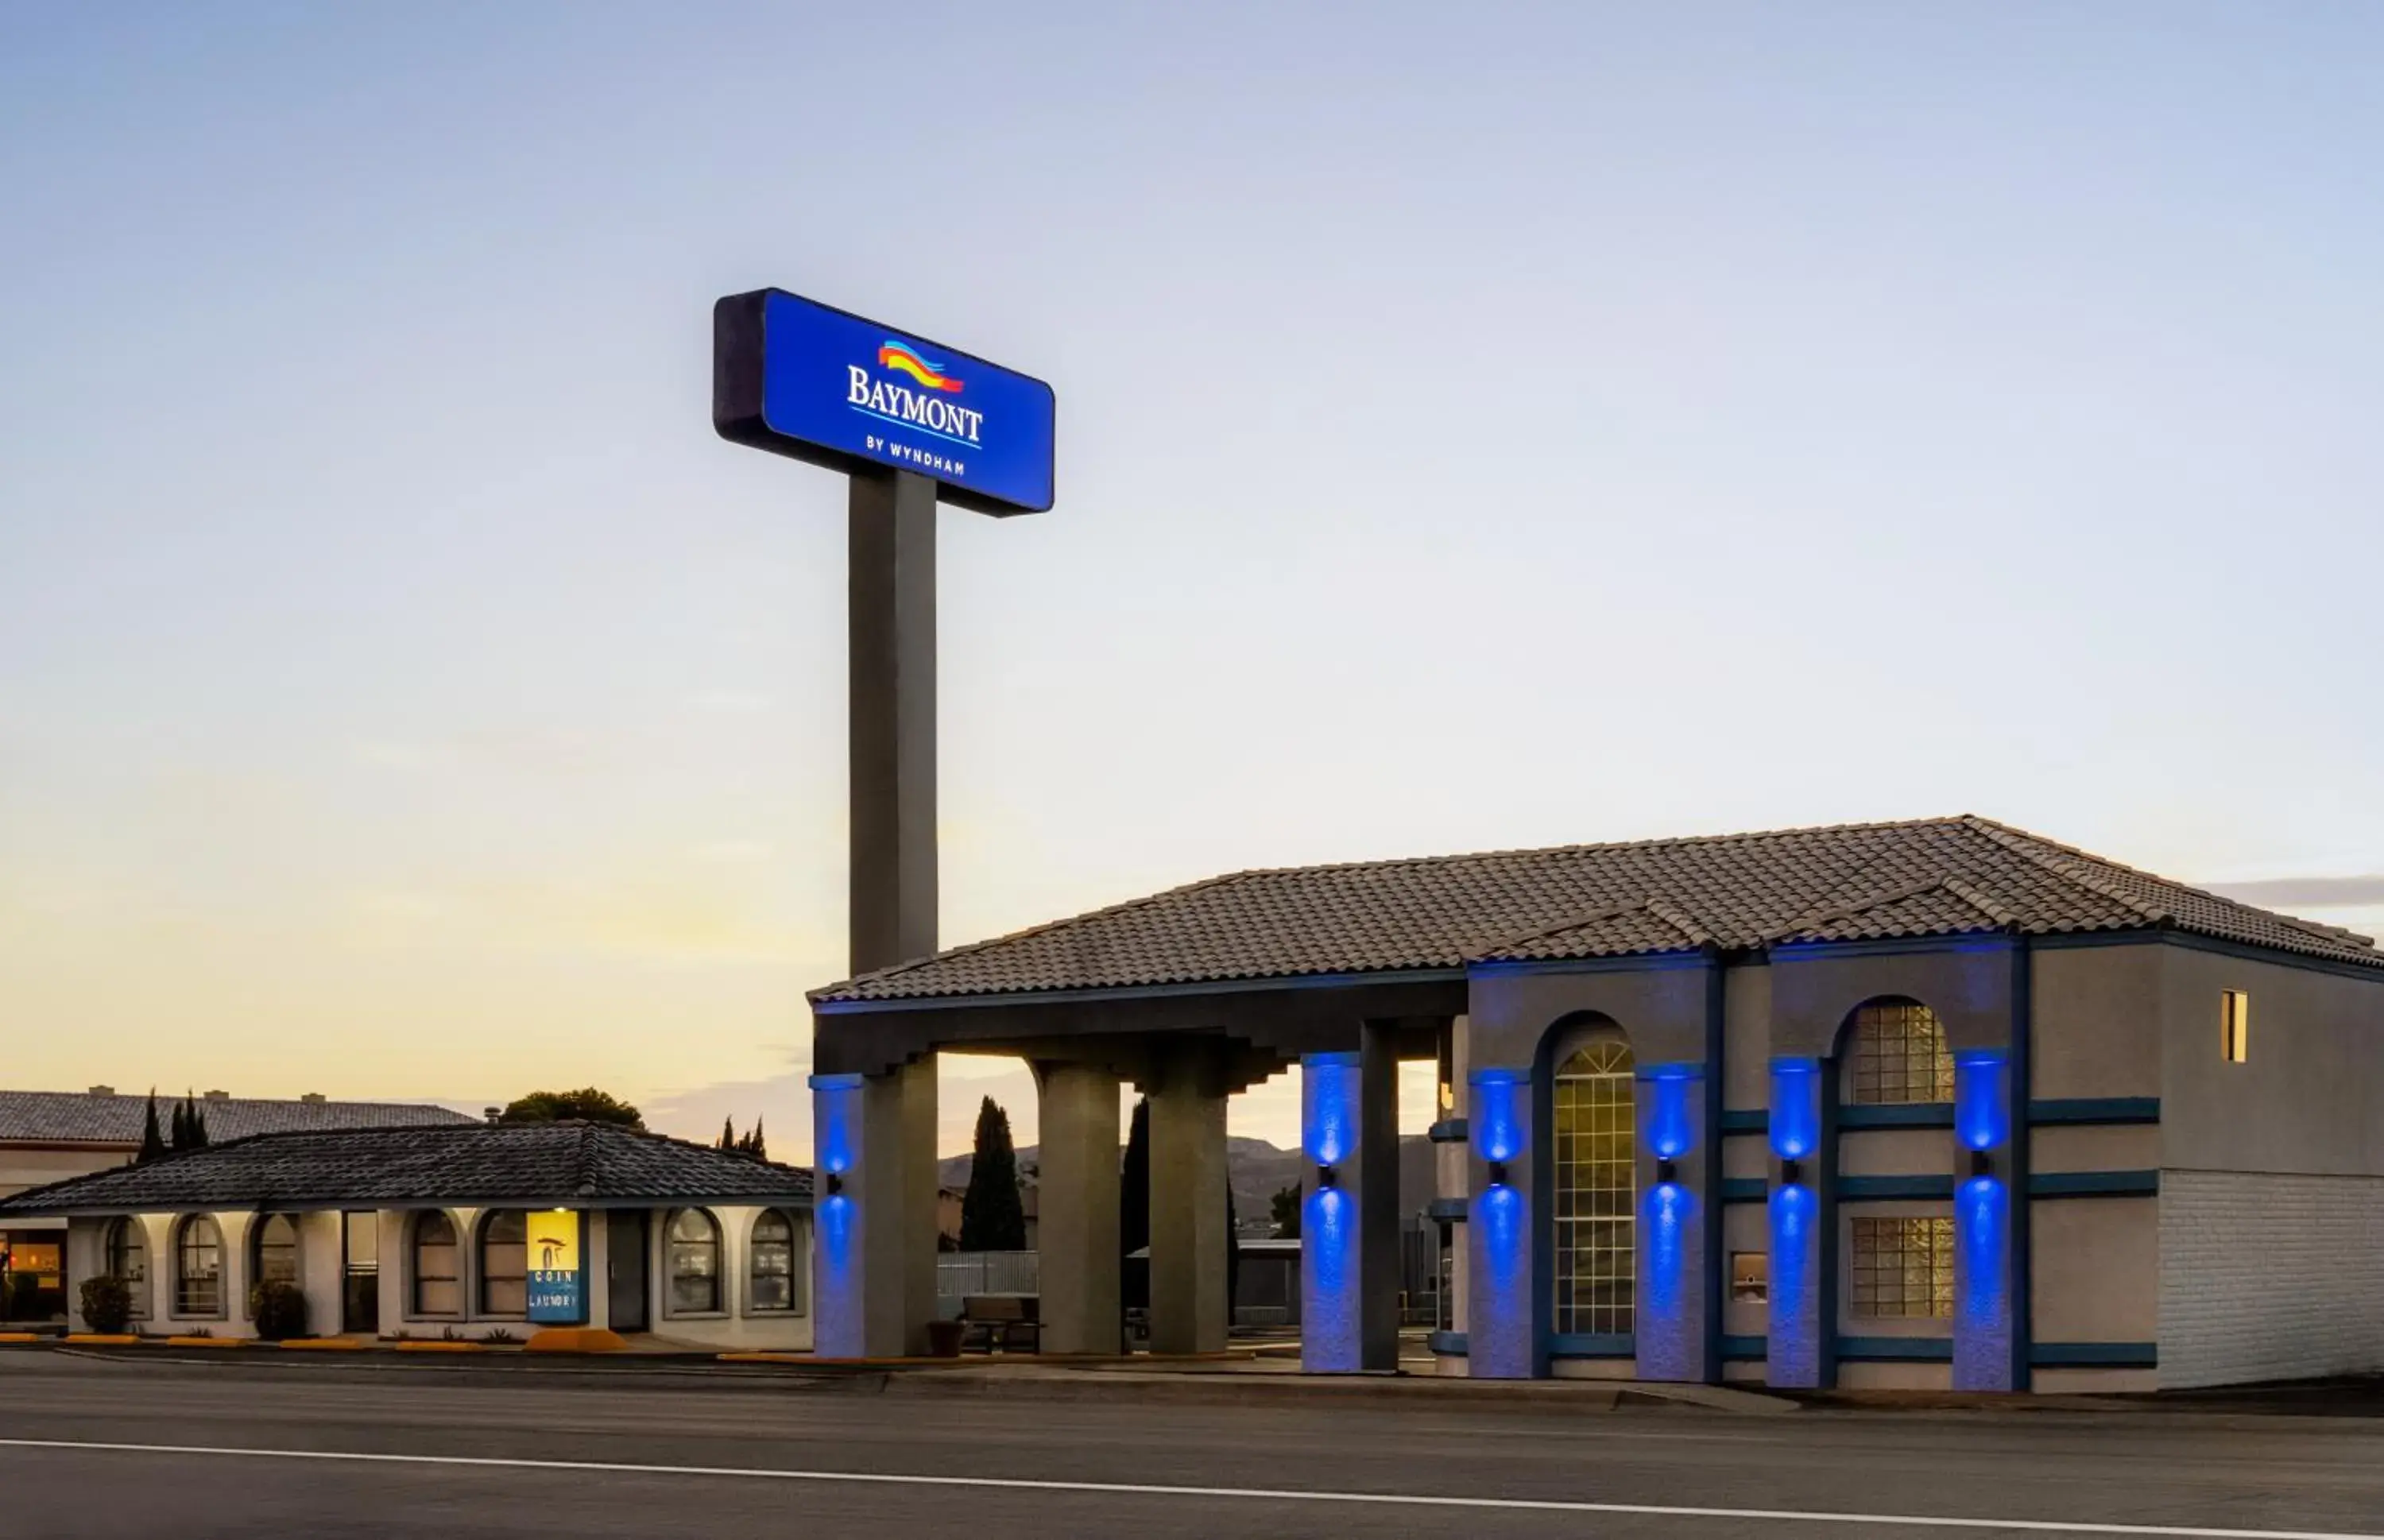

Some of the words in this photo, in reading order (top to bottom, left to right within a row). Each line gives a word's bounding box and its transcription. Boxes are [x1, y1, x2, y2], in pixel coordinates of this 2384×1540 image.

[847, 364, 982, 442] BAYMONT
[867, 435, 884, 451] BY
[890, 443, 964, 475] WYNDHAM
[535, 1271, 572, 1283] COIN
